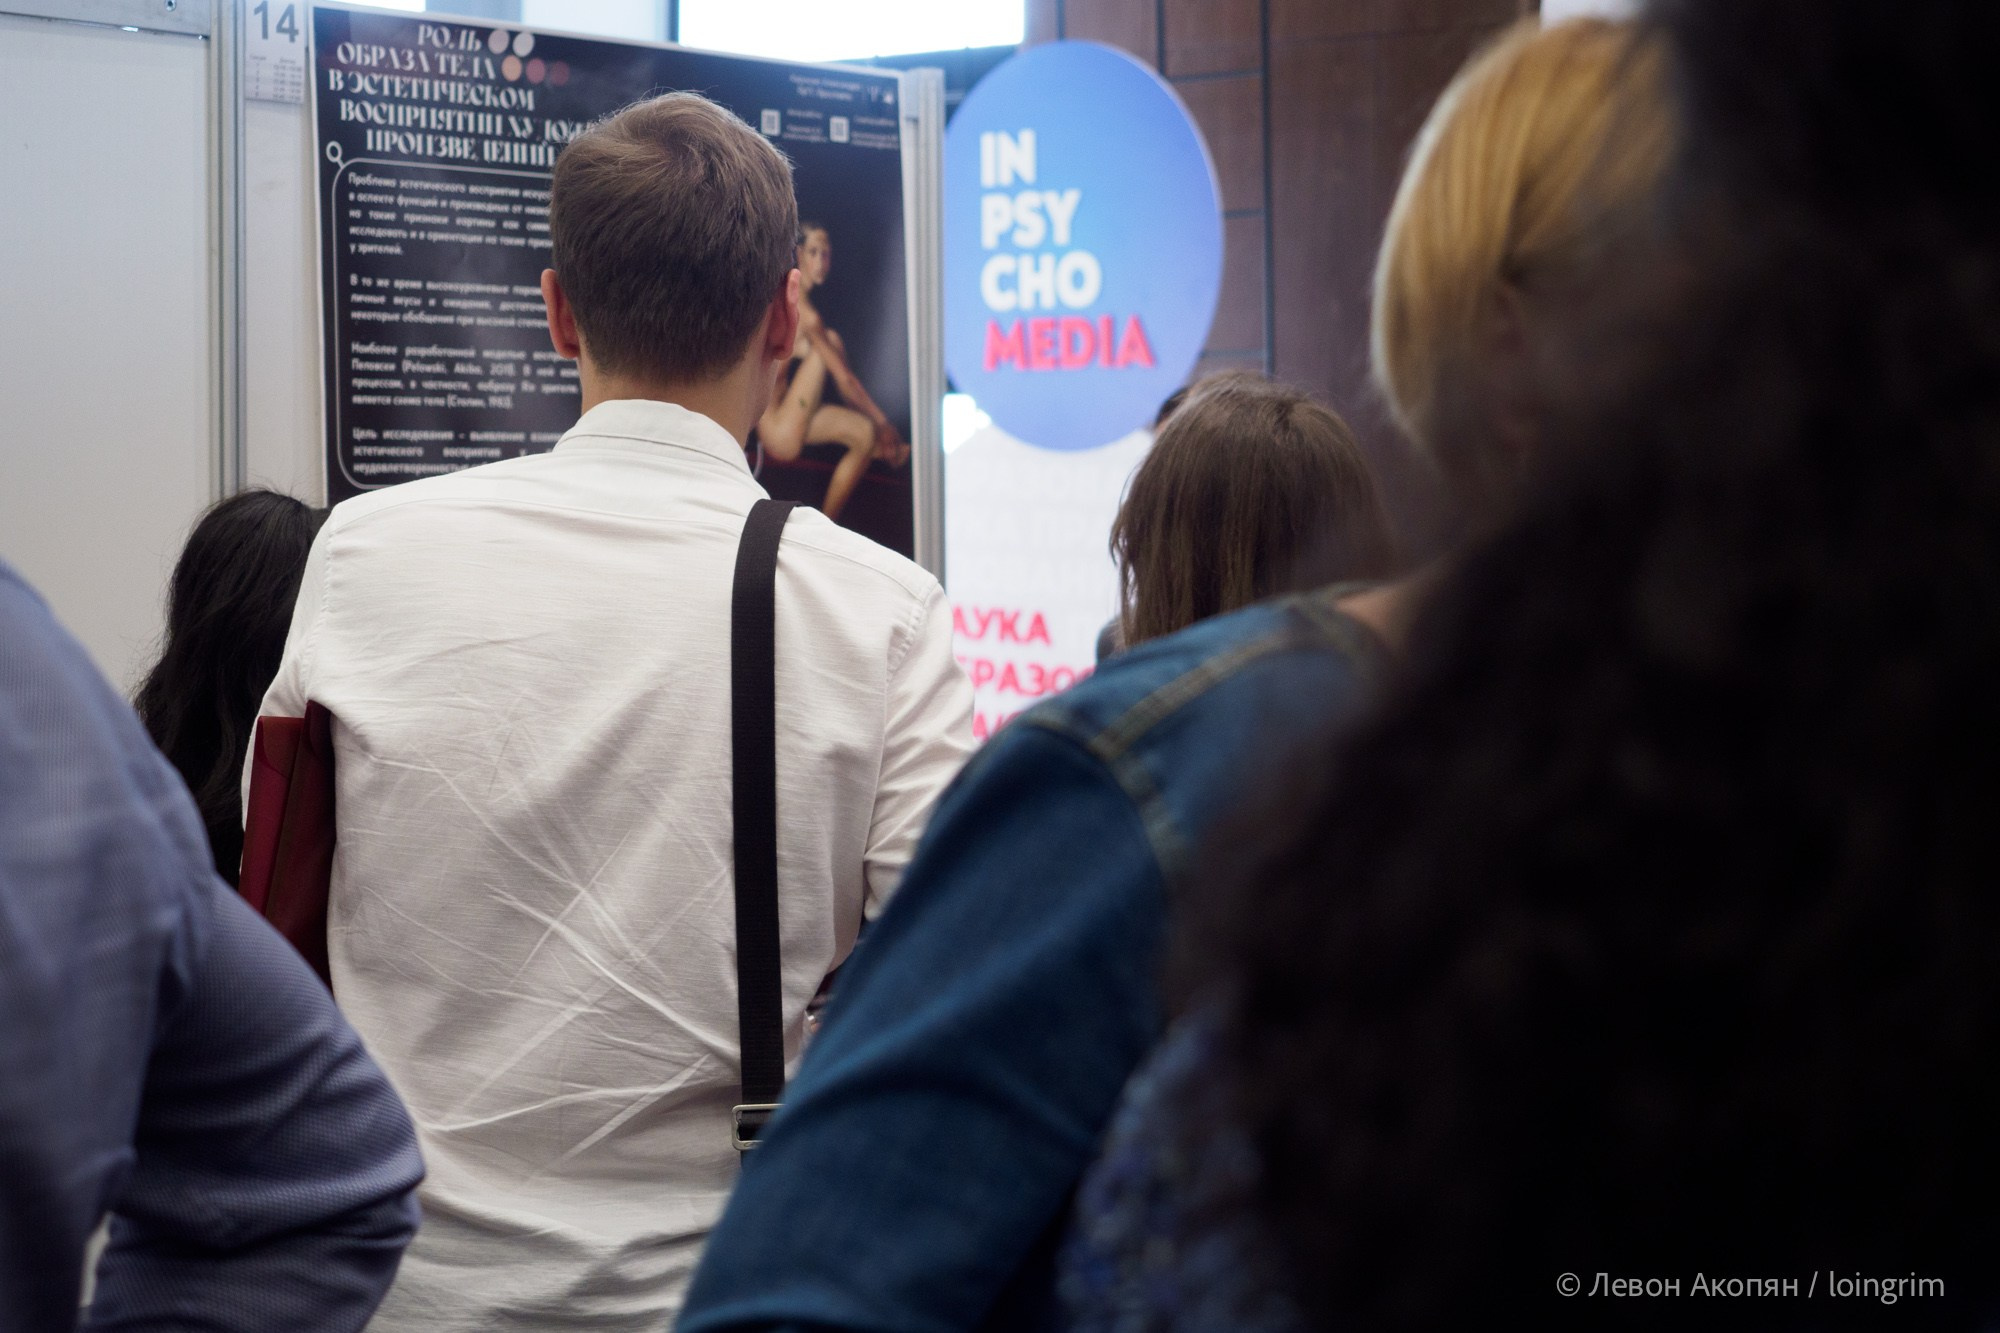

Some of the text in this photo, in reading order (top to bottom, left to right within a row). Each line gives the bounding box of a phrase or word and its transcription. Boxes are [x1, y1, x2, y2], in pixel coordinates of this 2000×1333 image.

[253, 0, 299, 43] 14
[417, 24, 482, 52] РОЛЬ
[336, 42, 496, 80] ОБРАЗА ТЕЛА
[329, 69, 344, 91] В
[349, 72, 535, 111] ЭСТЕТИЧЕСКОМ
[340, 99, 502, 136] ВОСПРИЯТИИ
[980, 129, 1036, 187] IN
[981, 189, 1081, 249] PSY
[980, 251, 1102, 312] CHO
[982, 313, 1156, 373] MEDIA
[953, 605, 1052, 648] АУКА
[957, 655, 1095, 697] РАЗО
